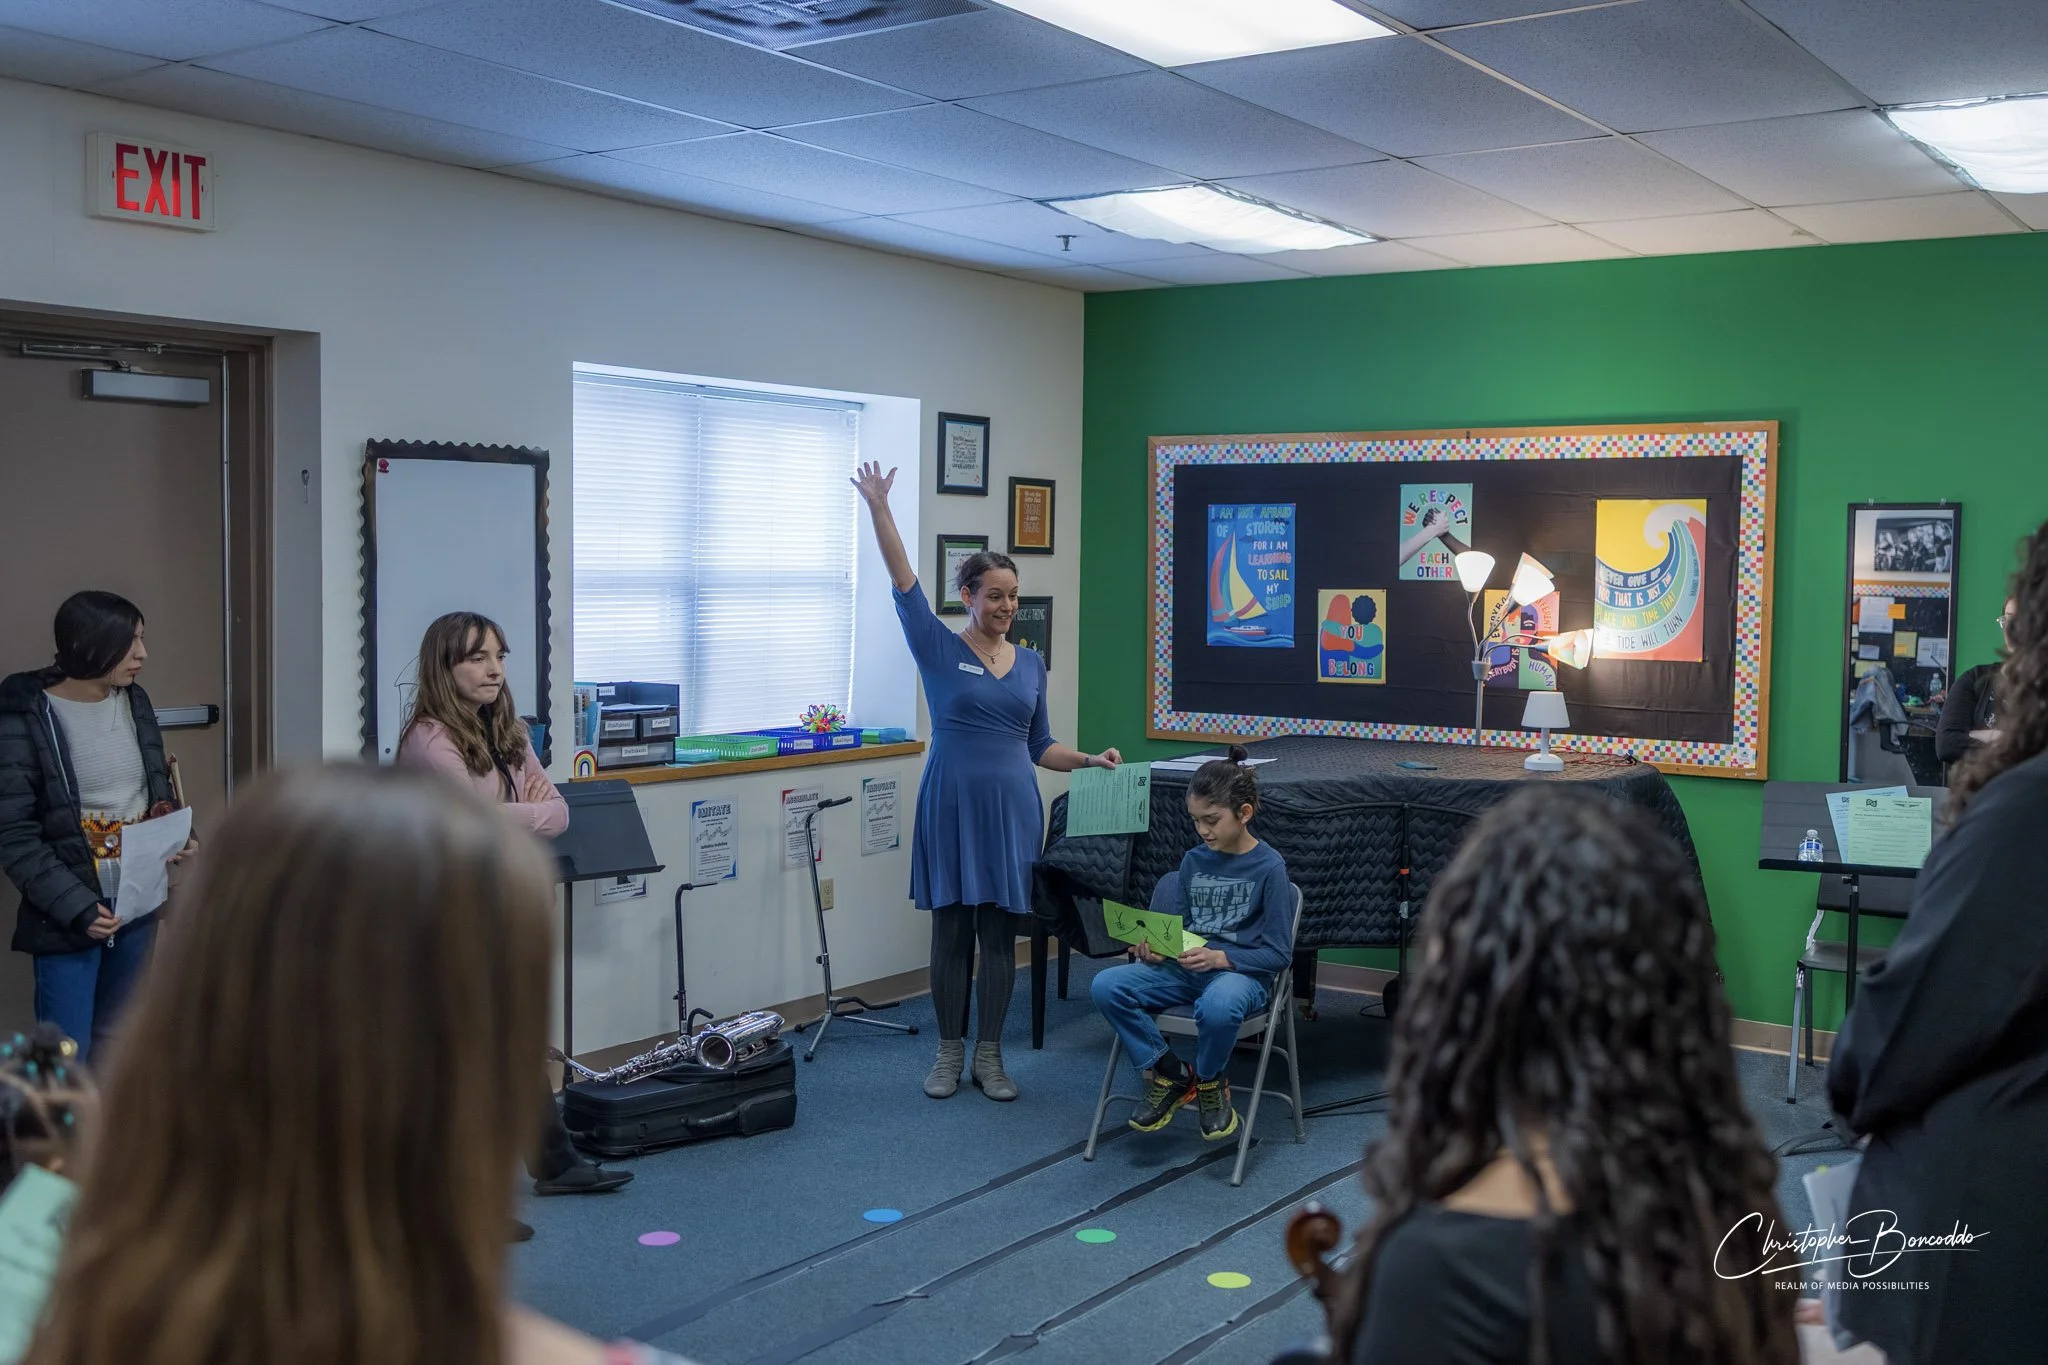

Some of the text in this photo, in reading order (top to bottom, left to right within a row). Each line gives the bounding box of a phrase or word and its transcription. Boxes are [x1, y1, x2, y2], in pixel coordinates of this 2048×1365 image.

[116, 143, 206, 220] EXIT
[1211, 506, 1292, 519] I AM NOT AFRAID
[1403, 490, 1468, 525] WE RESPECT
[1217, 521, 1286, 538] OF STORMS
[1254, 541, 1267, 550] FOR
[1276, 541, 1288, 550] AM
[1248, 552, 1292, 566] LEARNING
[1420, 553, 1449, 564] EACH
[1257, 569, 1289, 581] TO SAIL
[1417, 566, 1452, 578] OTHER
[1628, 574, 1647, 588] GIVE
[1650, 568, 1661, 581] UP
[1266, 583, 1279, 595] MY
[1615, 591, 1632, 607] THAT
[1636, 592, 1643, 605] IS
[1647, 587, 1661, 603] JUST
[1663, 573, 1672, 587] THE
[1265, 594, 1291, 611] SHIP
[1622, 615, 1636, 628] AND
[1642, 610, 1659, 625] TIME
[1660, 592, 1676, 612] THAT
[1340, 626, 1363, 640] YOU
[1617, 635, 1635, 649] TIDE
[1641, 632, 1660, 647] WILL
[1663, 613, 1683, 636] TURN
[1328, 659, 1375, 676] BELONG
[1528, 660, 1554, 687] HUMAN
[697, 804, 731, 818] IMITATE
[1190, 881, 1256, 907] TOP OF MY
